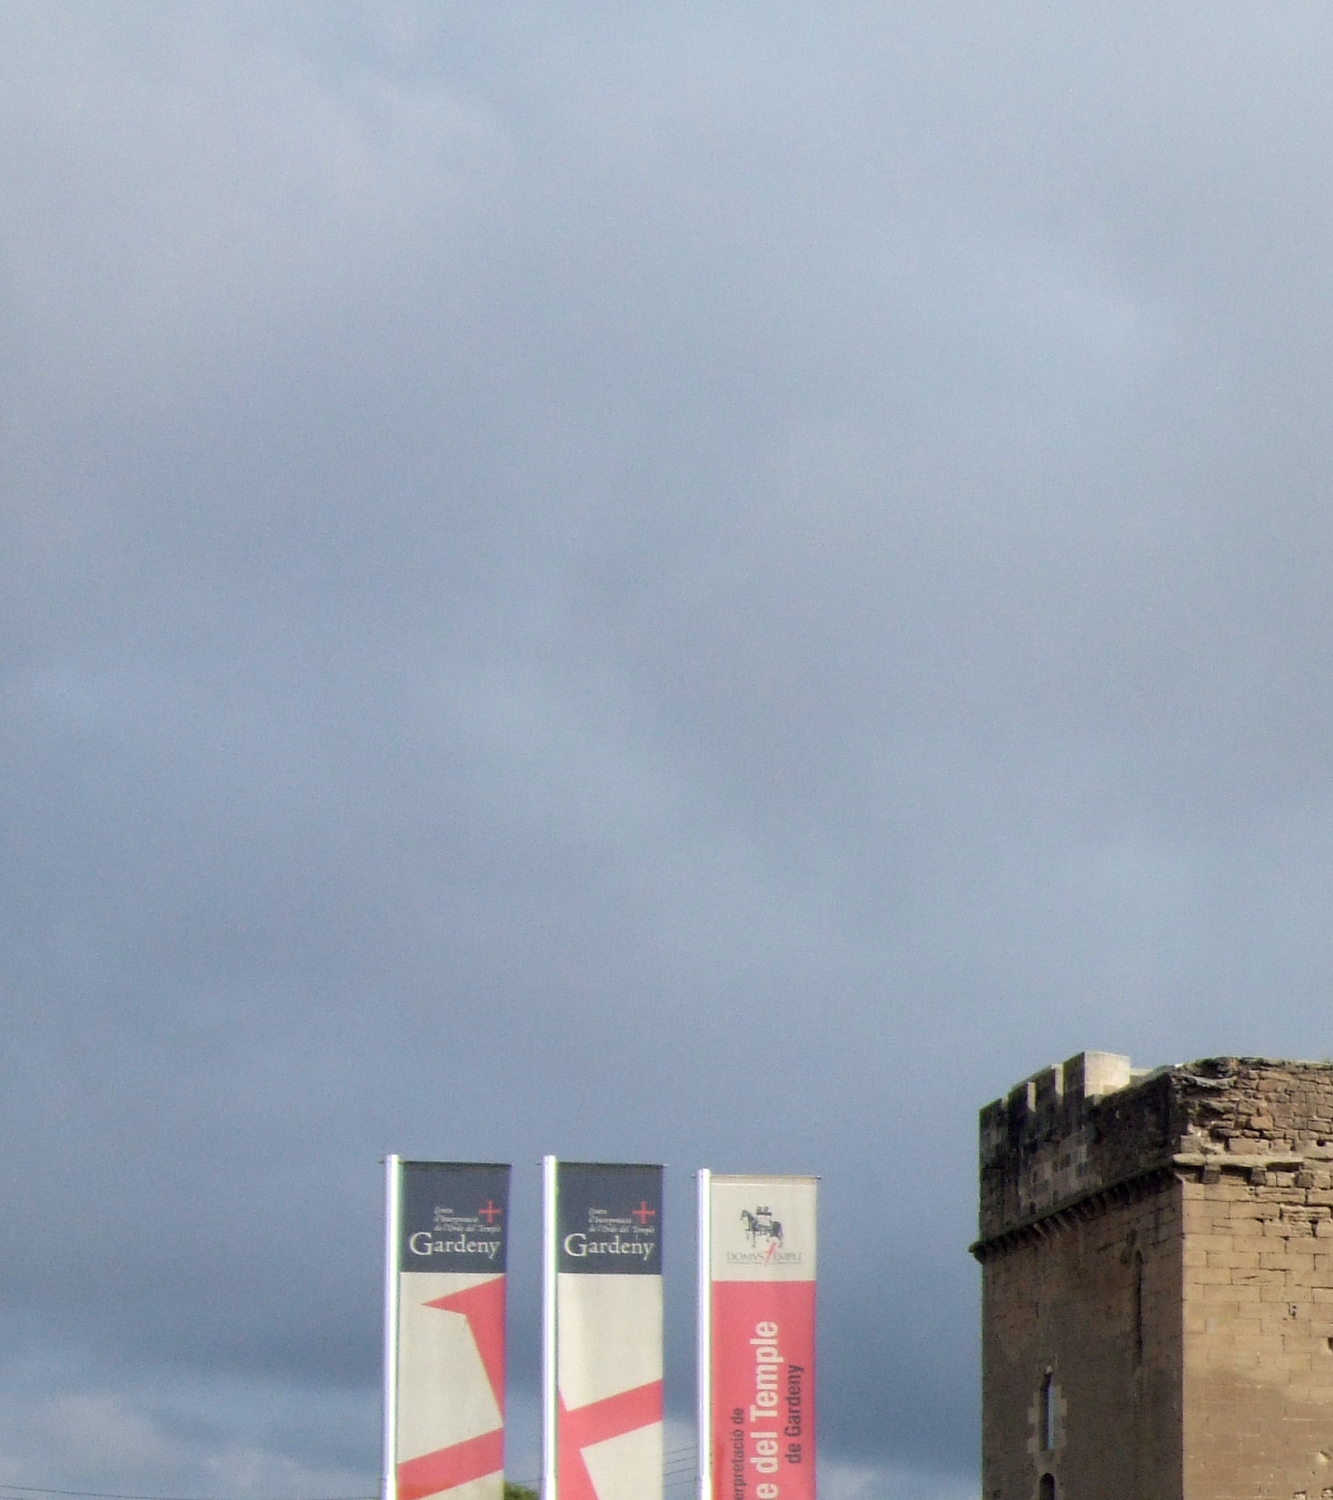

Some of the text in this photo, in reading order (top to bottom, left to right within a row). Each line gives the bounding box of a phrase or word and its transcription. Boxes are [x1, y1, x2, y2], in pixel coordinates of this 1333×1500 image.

[409, 1232, 500, 1260] Gardeny
[564, 1233, 655, 1261] Gardeny
[750, 1321, 784, 1422] Temple
[731, 1407, 744, 1424] de
[784, 1364, 804, 1464] de Gardeny
[751, 1432, 778, 1473] del
